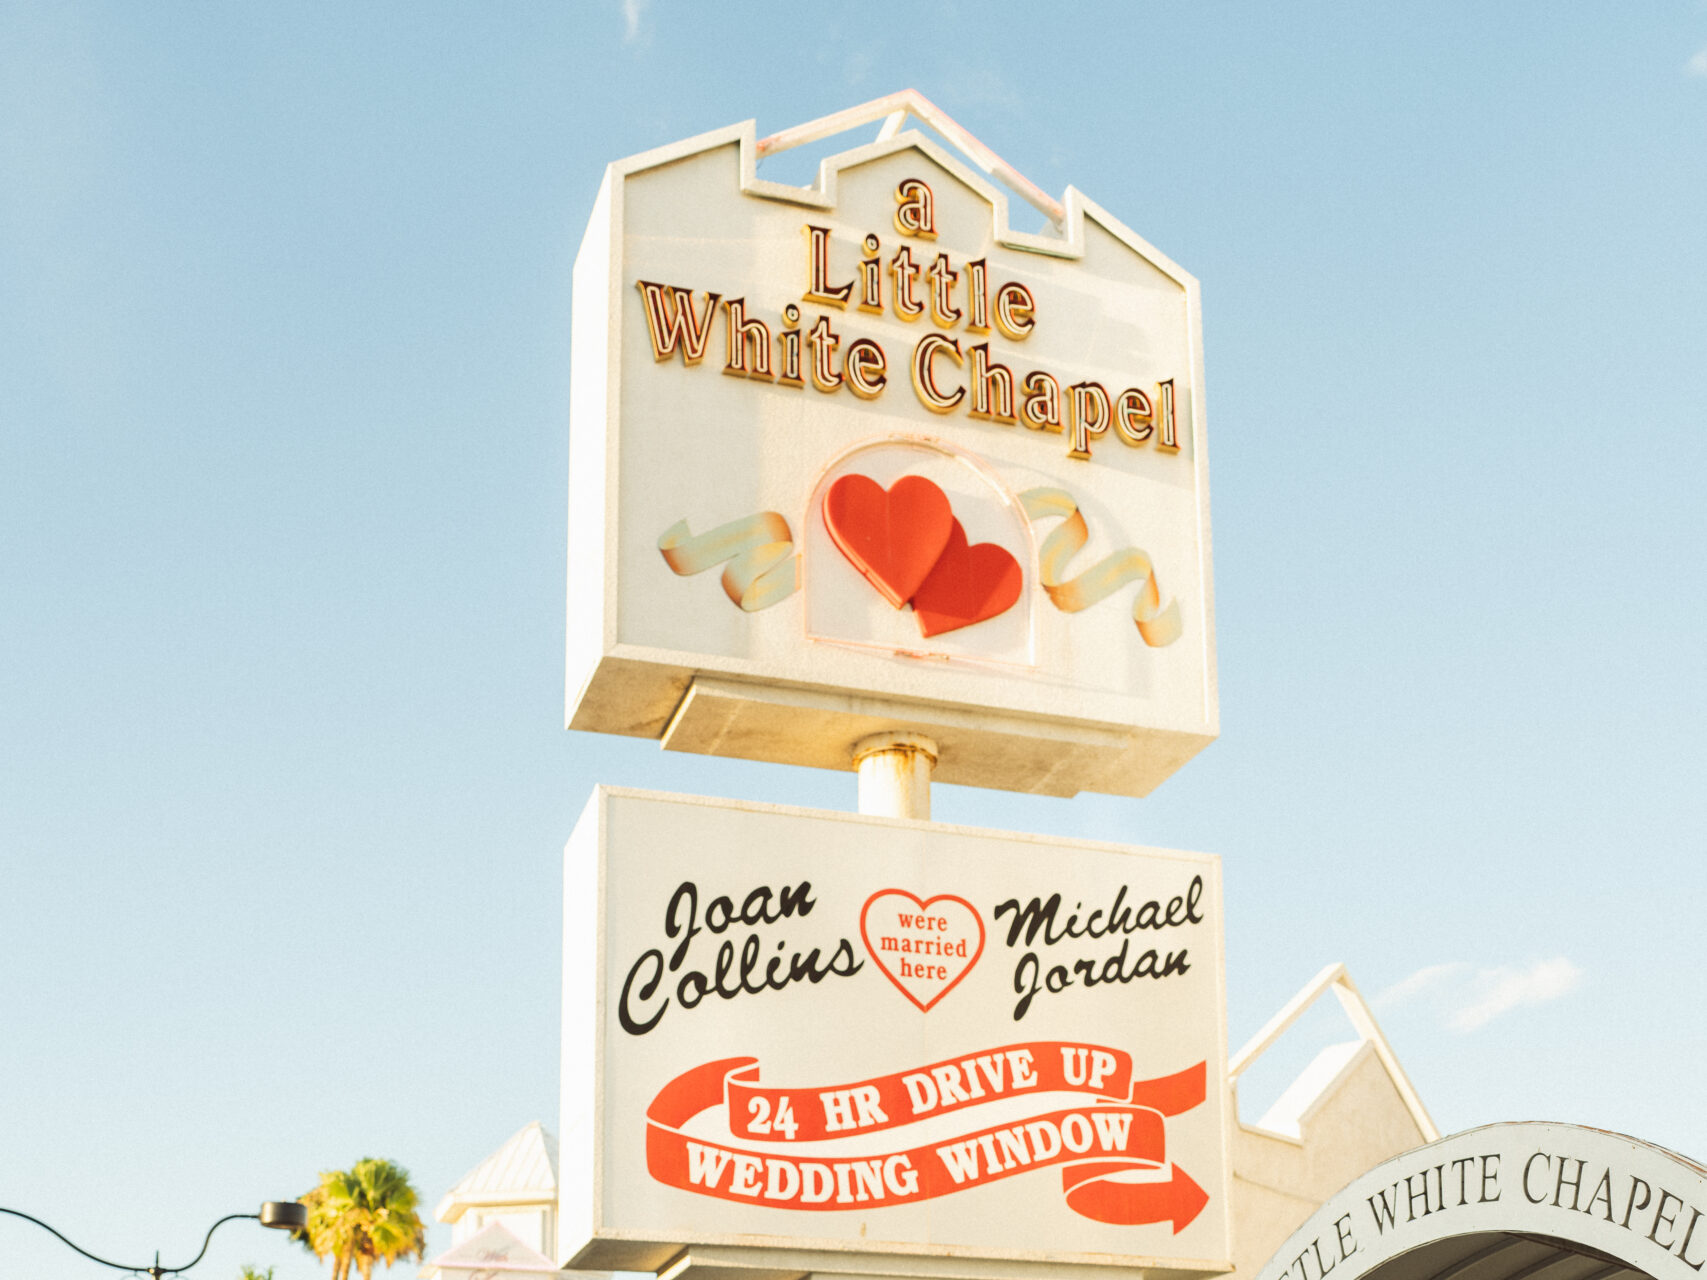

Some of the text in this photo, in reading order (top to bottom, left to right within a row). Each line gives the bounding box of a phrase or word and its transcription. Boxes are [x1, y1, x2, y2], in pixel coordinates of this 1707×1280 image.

[893, 179, 940, 243] a
[801, 224, 1037, 341] Little
[636, 279, 1181, 459] White Chapel
[665, 881, 817, 971] Joan
[880, 934, 968, 959] married
[898, 910, 948, 932] were
[994, 875, 1204, 947] Michael
[618, 933, 865, 1036] Collins
[899, 956, 948, 982] here
[1013, 937, 1192, 1021] Jordan
[747, 1045, 1118, 1140] 24 HR DRIVE UP
[686, 1113, 1133, 1204] WEDDING WINDOW
[1366, 1153, 1502, 1236] WHITE
[1522, 1151, 1706, 1272] CHAPEL
